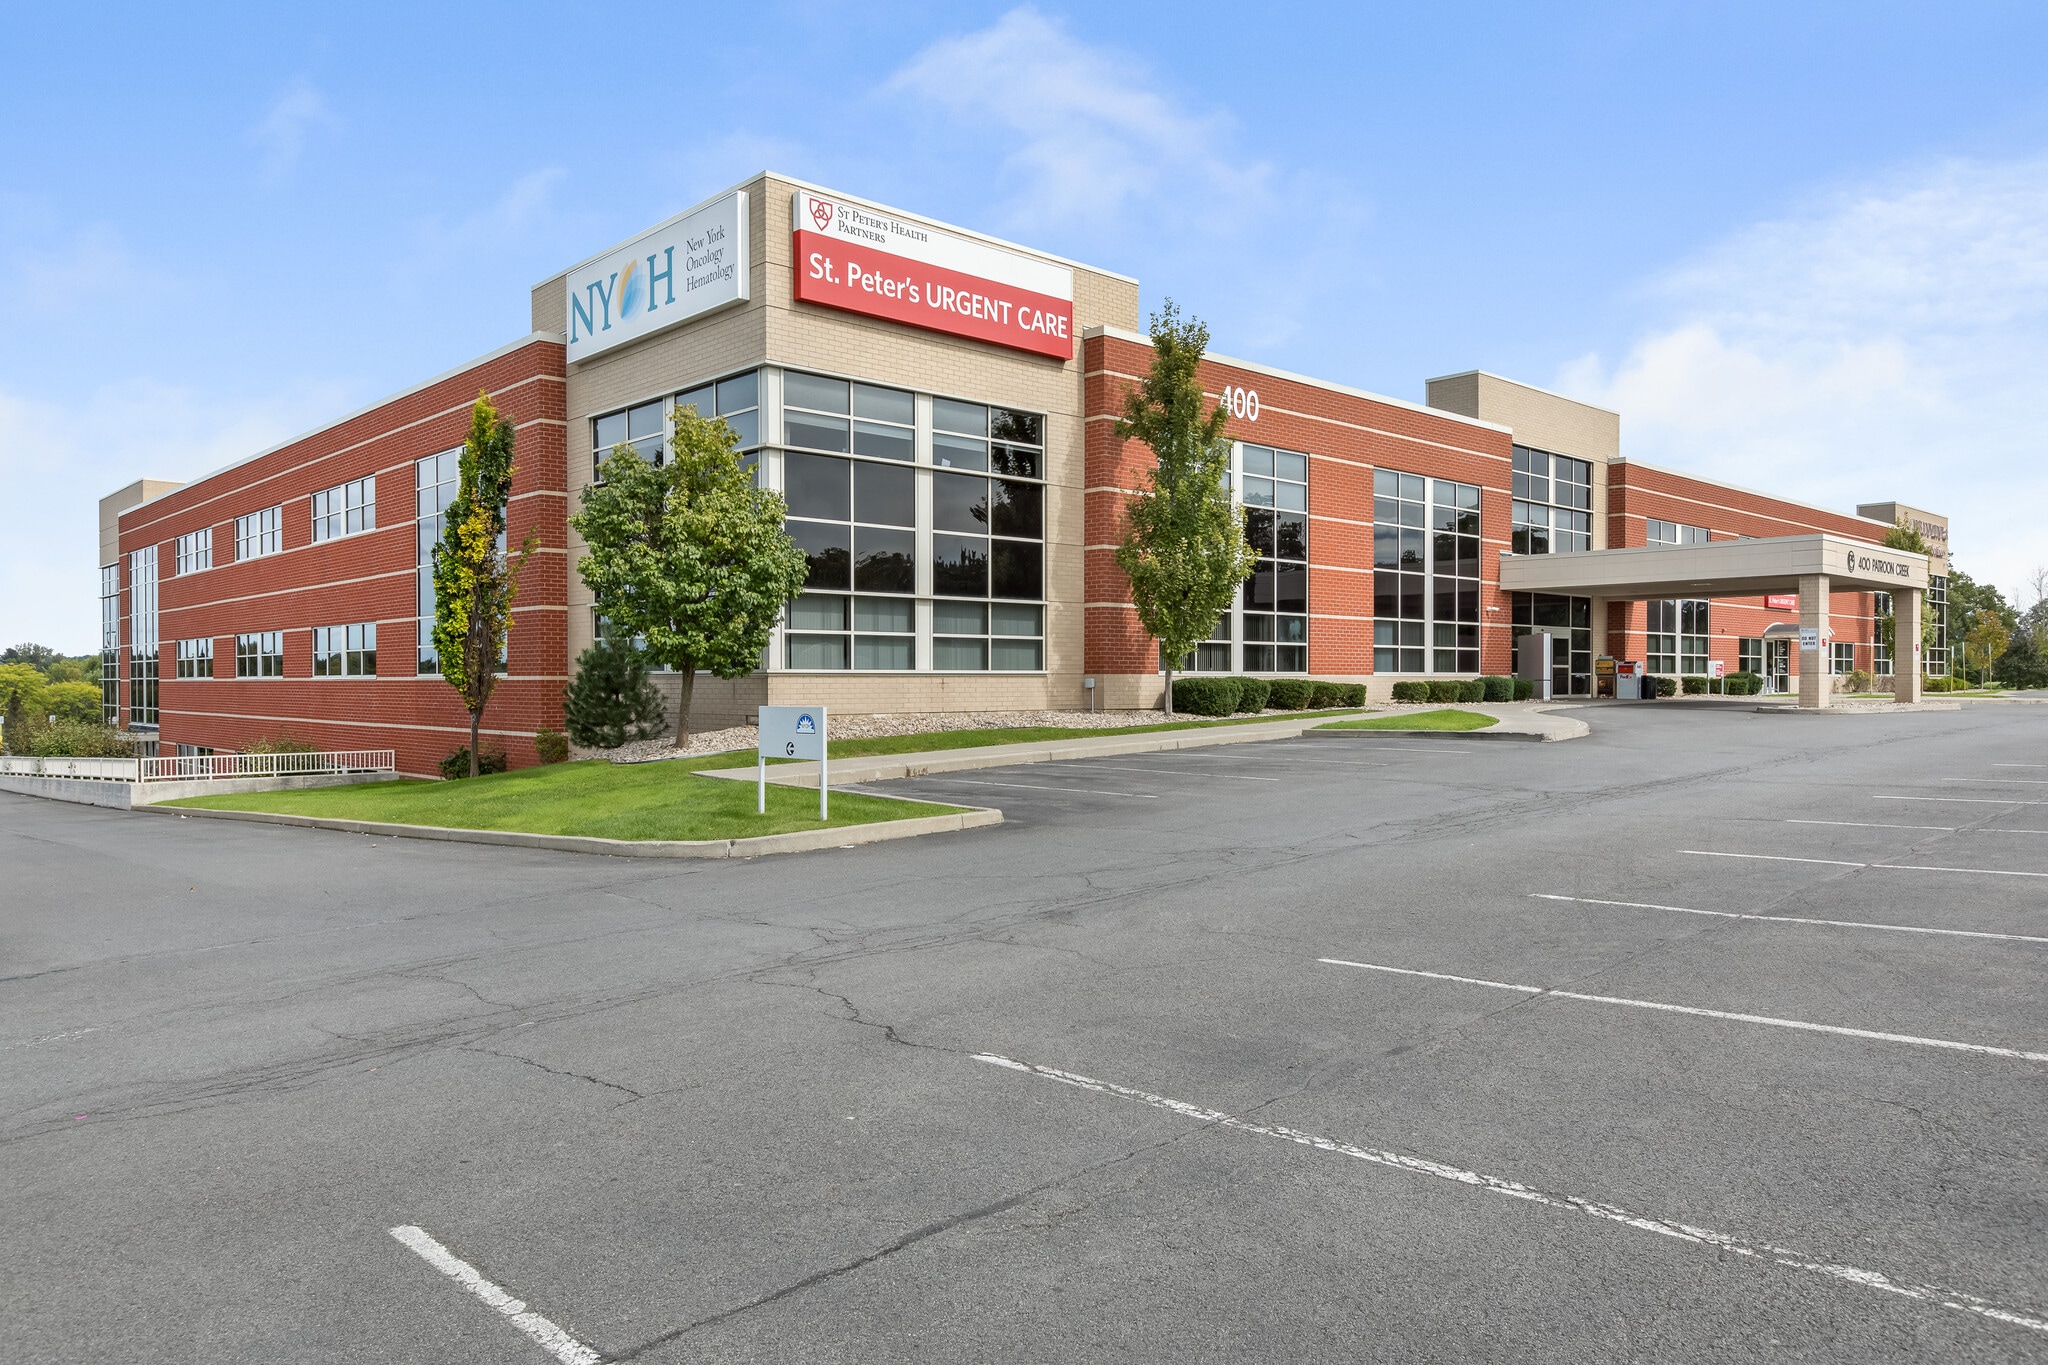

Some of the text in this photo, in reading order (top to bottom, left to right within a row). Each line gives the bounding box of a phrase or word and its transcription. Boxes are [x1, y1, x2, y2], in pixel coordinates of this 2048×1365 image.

[686, 224, 725, 255] New York
[686, 247, 725, 272] Oncology
[686, 263, 735, 292] Hematology
[808, 252, 1068, 339] St. Peter's URGENT CARE
[1220, 385, 1260, 422] 400
[1858, 556, 1871, 571] 400
[1896, 563, 1910, 577] CREEK
